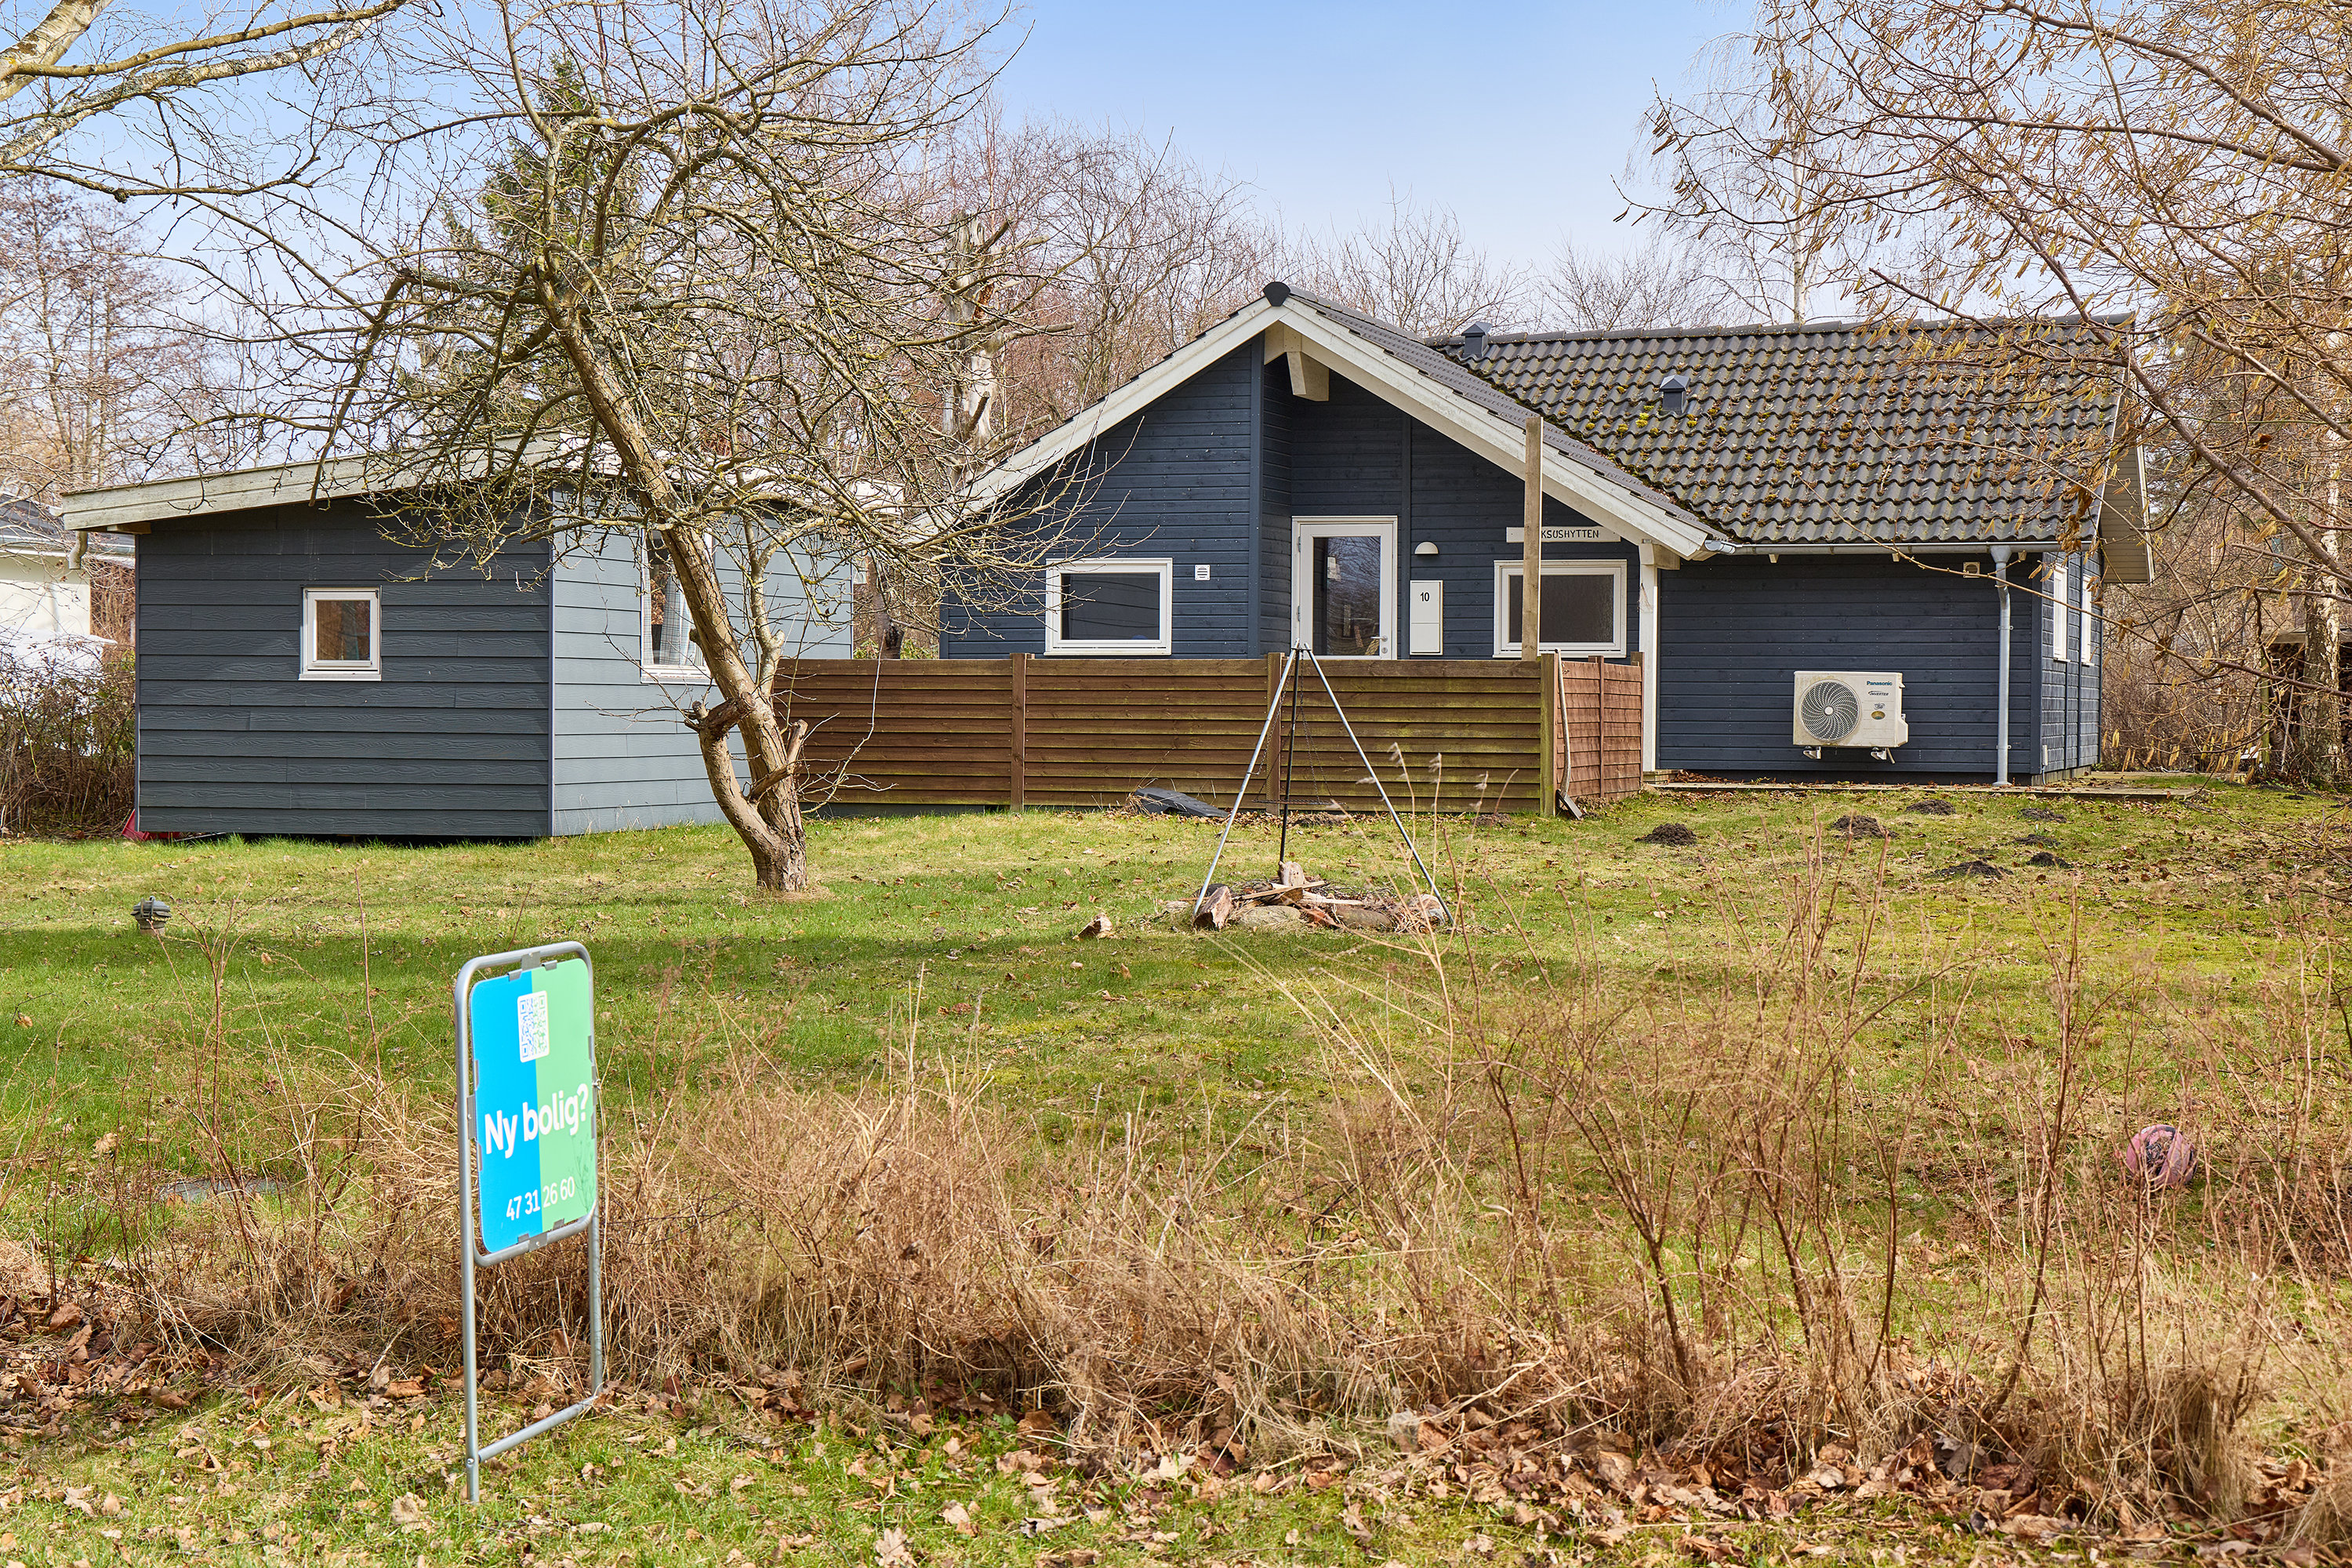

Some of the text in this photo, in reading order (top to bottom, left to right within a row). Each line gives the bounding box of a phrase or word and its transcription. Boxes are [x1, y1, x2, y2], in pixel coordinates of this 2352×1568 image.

[1541, 529, 1599, 539] KSUSHYTTEN
[1420, 592, 1430, 602] 10
[485, 1083, 589, 1159] Ny bolig?
[506, 1176, 575, 1221] 47 31 26 60
